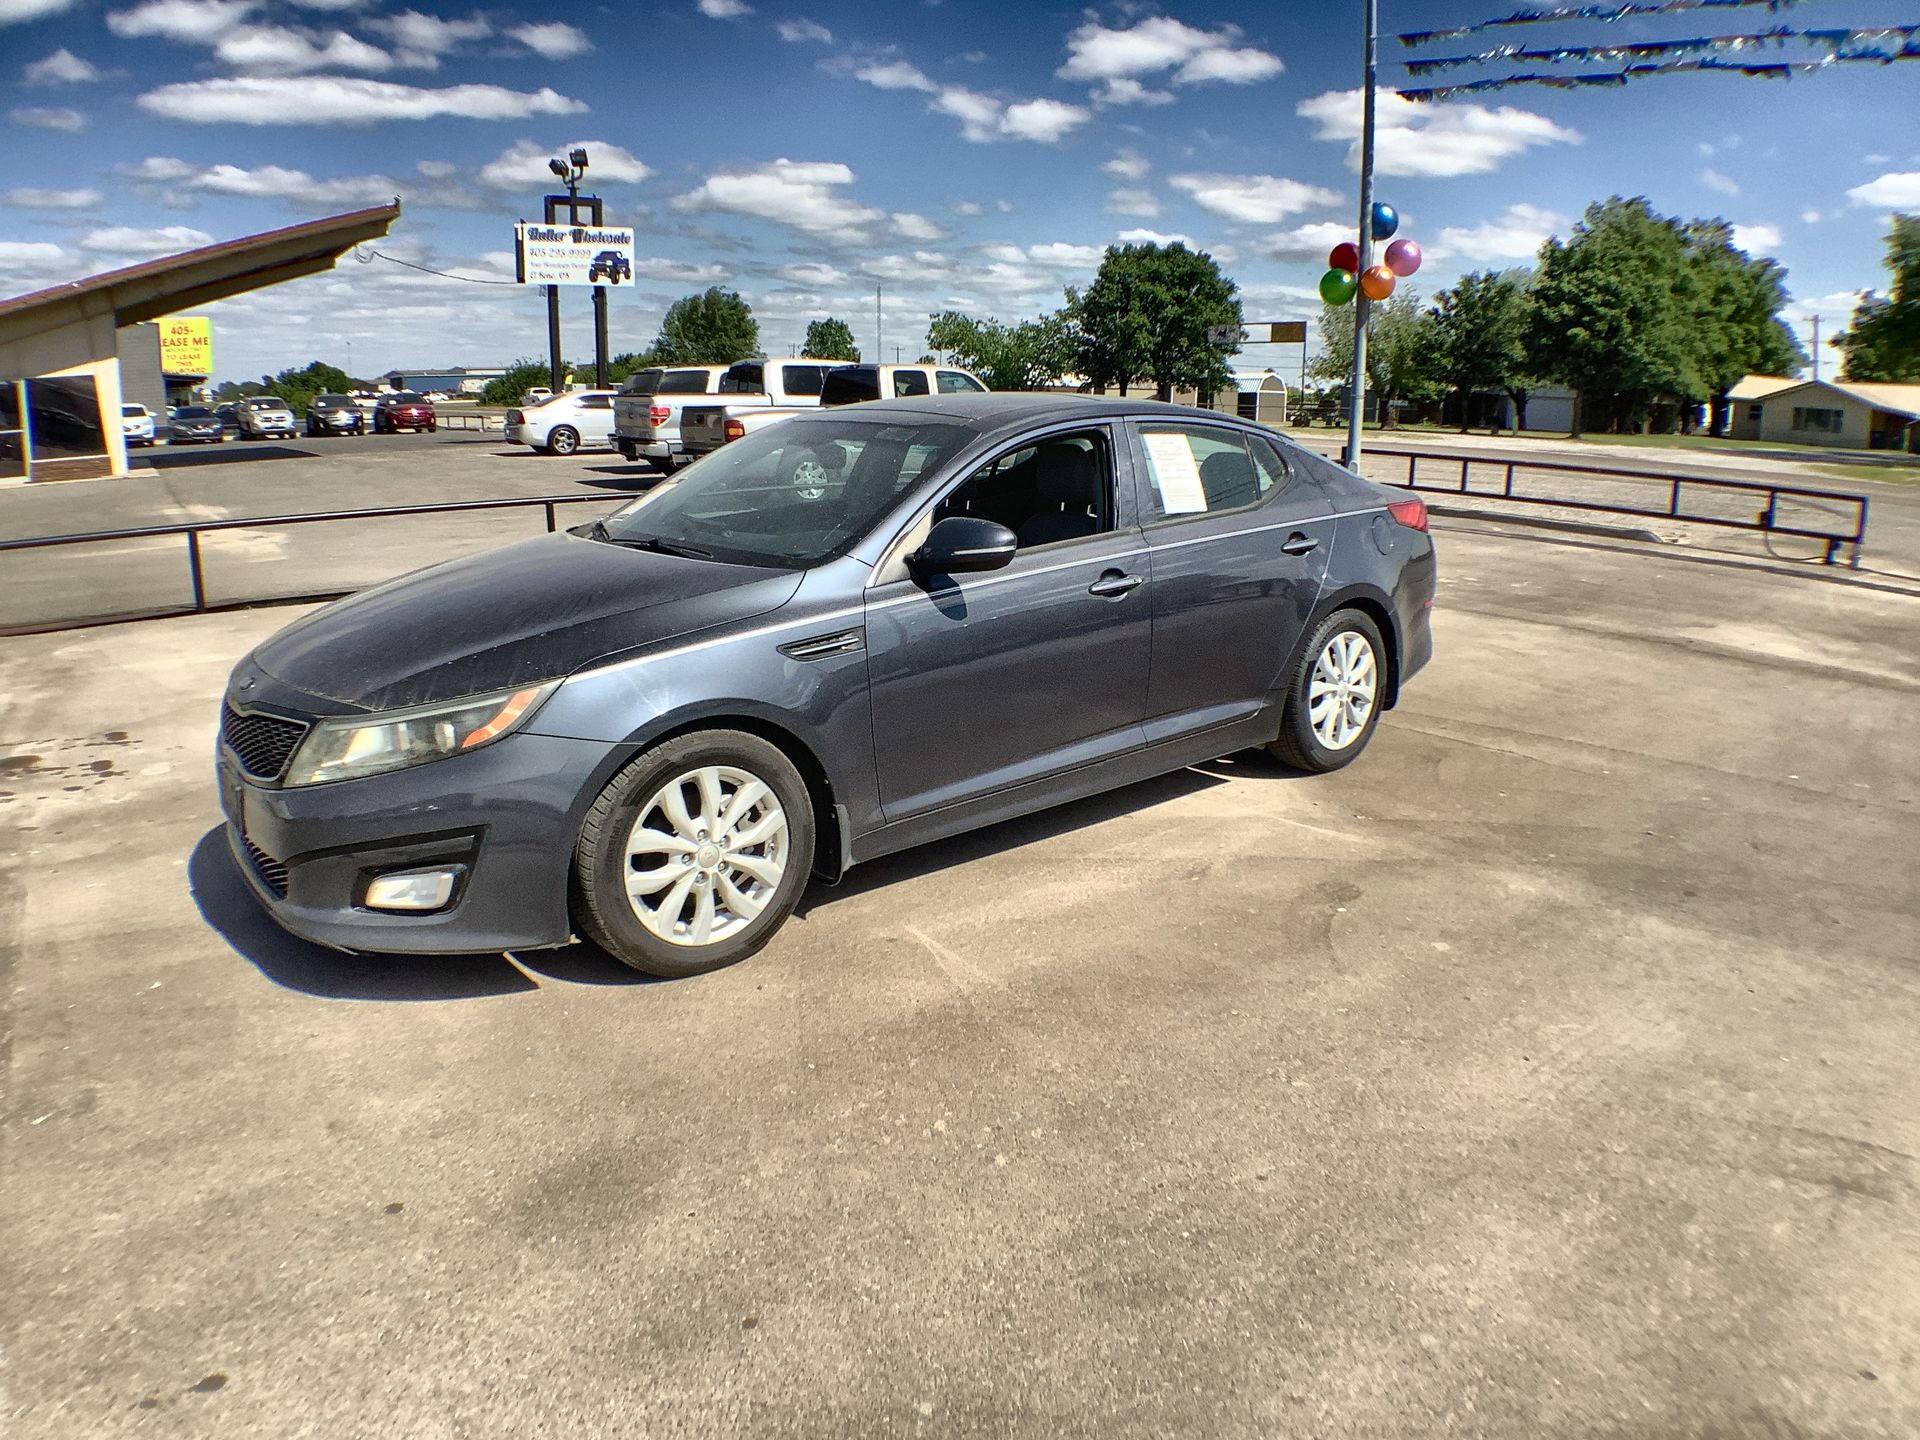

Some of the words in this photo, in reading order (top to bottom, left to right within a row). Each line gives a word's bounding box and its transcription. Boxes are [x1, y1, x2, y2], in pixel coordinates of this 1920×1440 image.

[569, 228, 631, 244] Wholesale
[170, 326, 194, 335] 405-
[161, 337, 188, 347] EASE
[192, 336, 209, 346] ME
